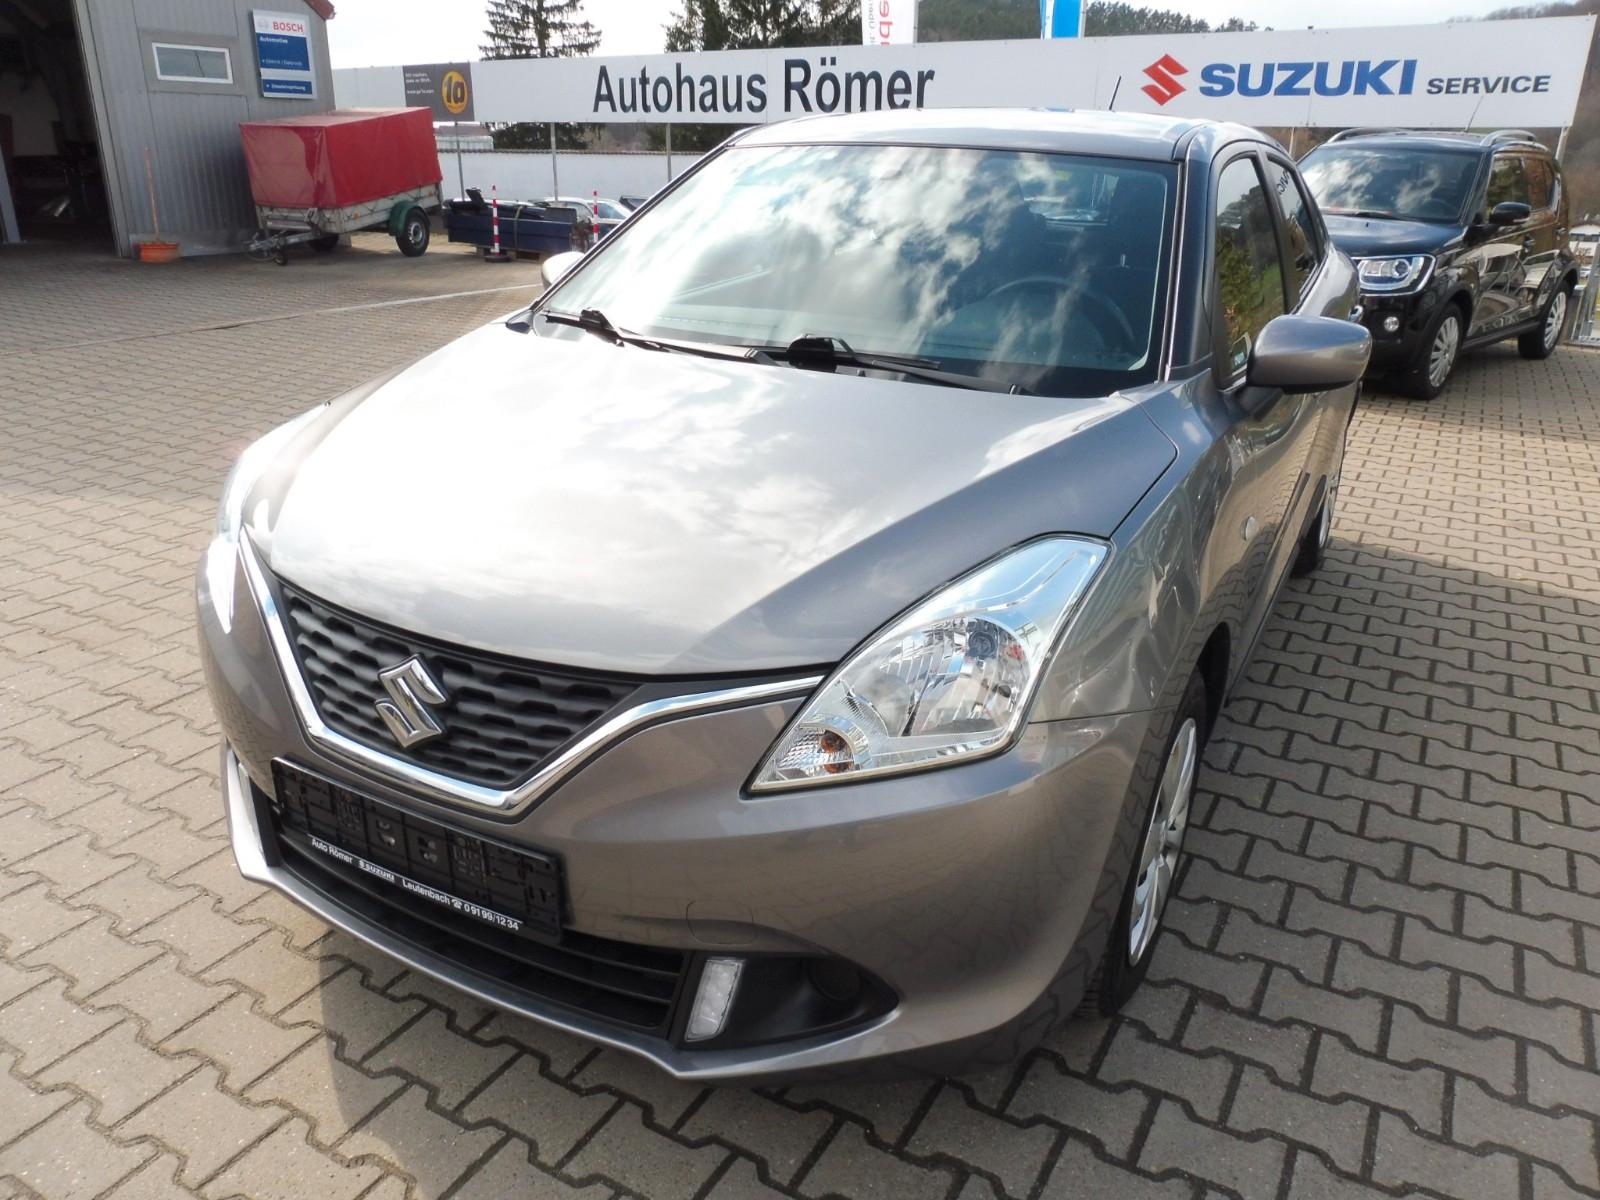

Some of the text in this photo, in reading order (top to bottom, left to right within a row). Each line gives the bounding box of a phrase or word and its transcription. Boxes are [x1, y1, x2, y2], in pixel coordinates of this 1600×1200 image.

[272, 21, 304, 33] BOSCH
[593, 56, 935, 113] Autohaus Römer
[1199, 59, 1551, 97] SUZUKI SERVICE
[312, 838, 328, 852] Auto
[329, 846, 352, 863] Römer
